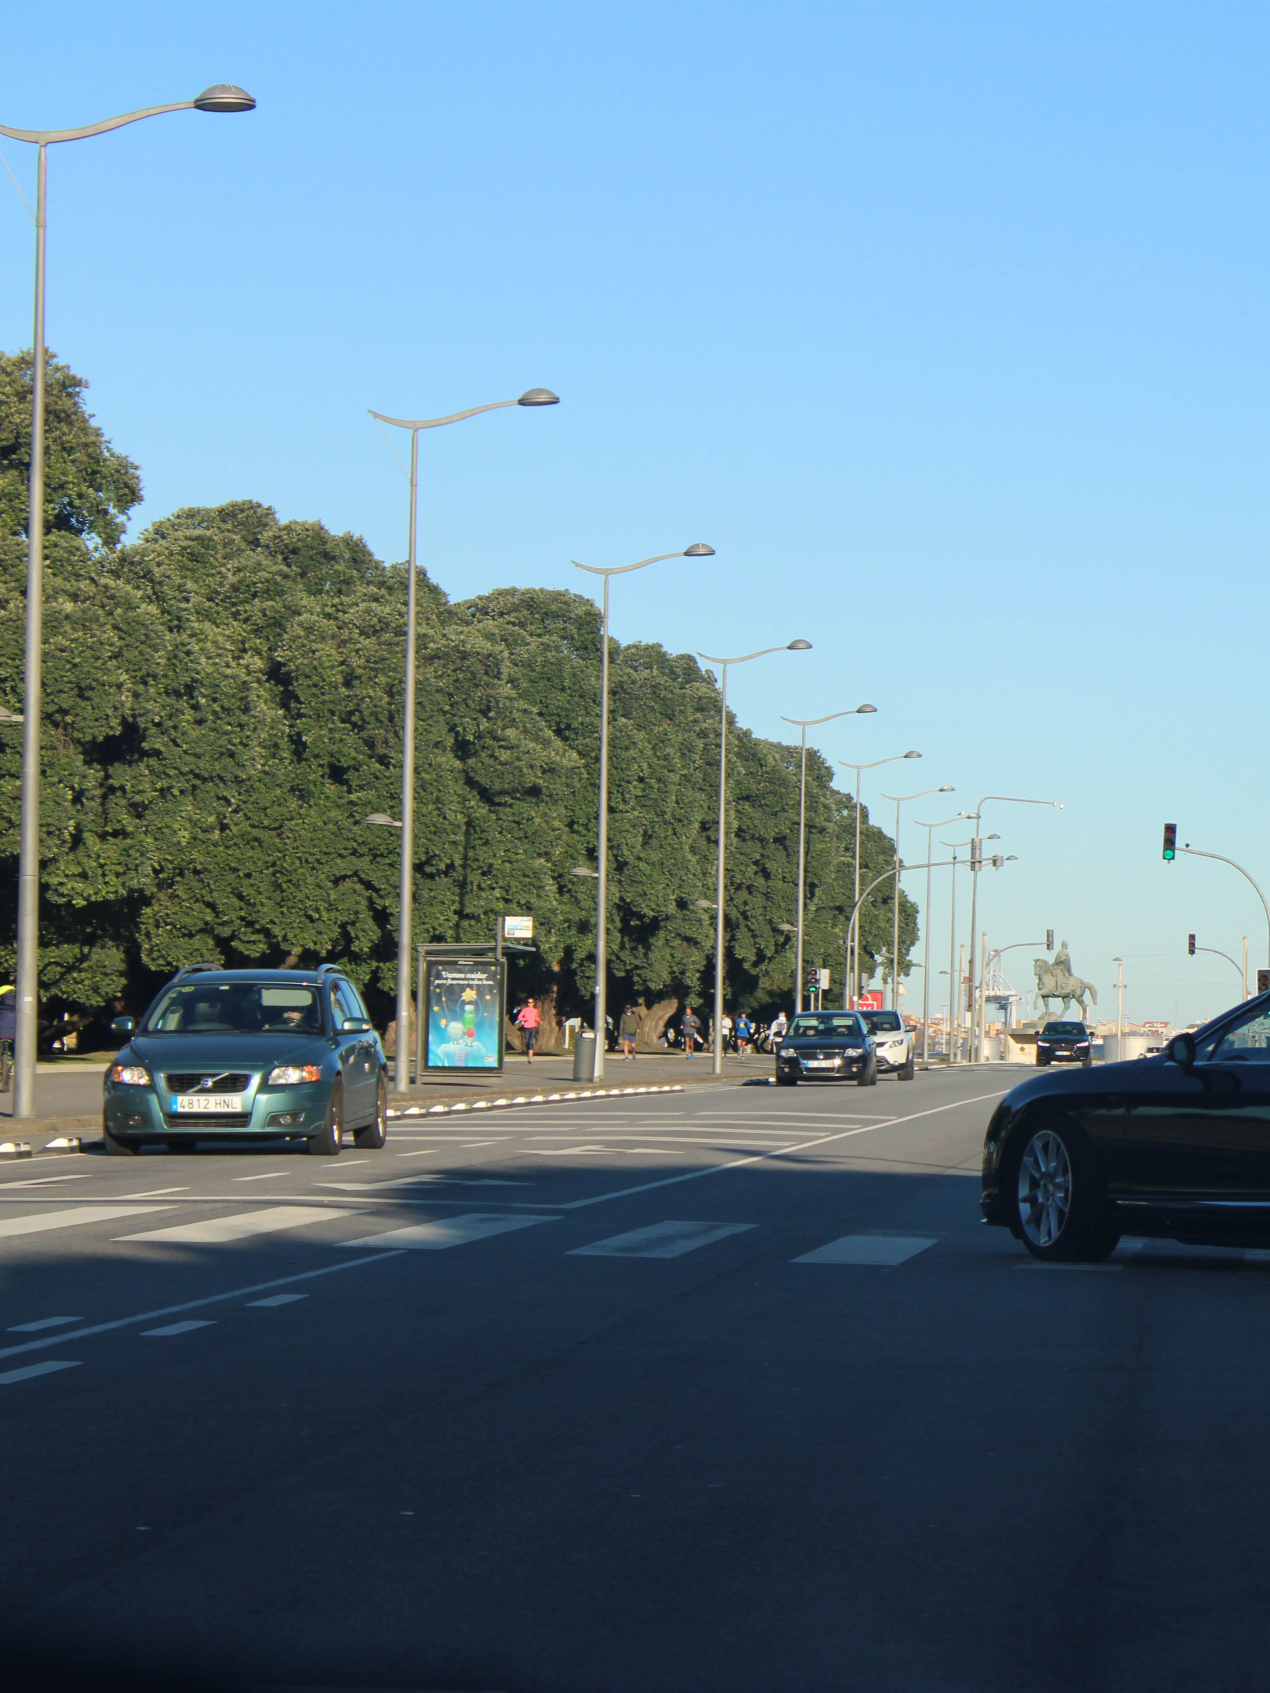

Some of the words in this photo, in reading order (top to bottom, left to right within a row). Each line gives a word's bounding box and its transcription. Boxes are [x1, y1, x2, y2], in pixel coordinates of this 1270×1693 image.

[465, 971, 488, 979] cuidar
[179, 1098, 210, 1110] 4812
[214, 1098, 238, 1110] HNL
